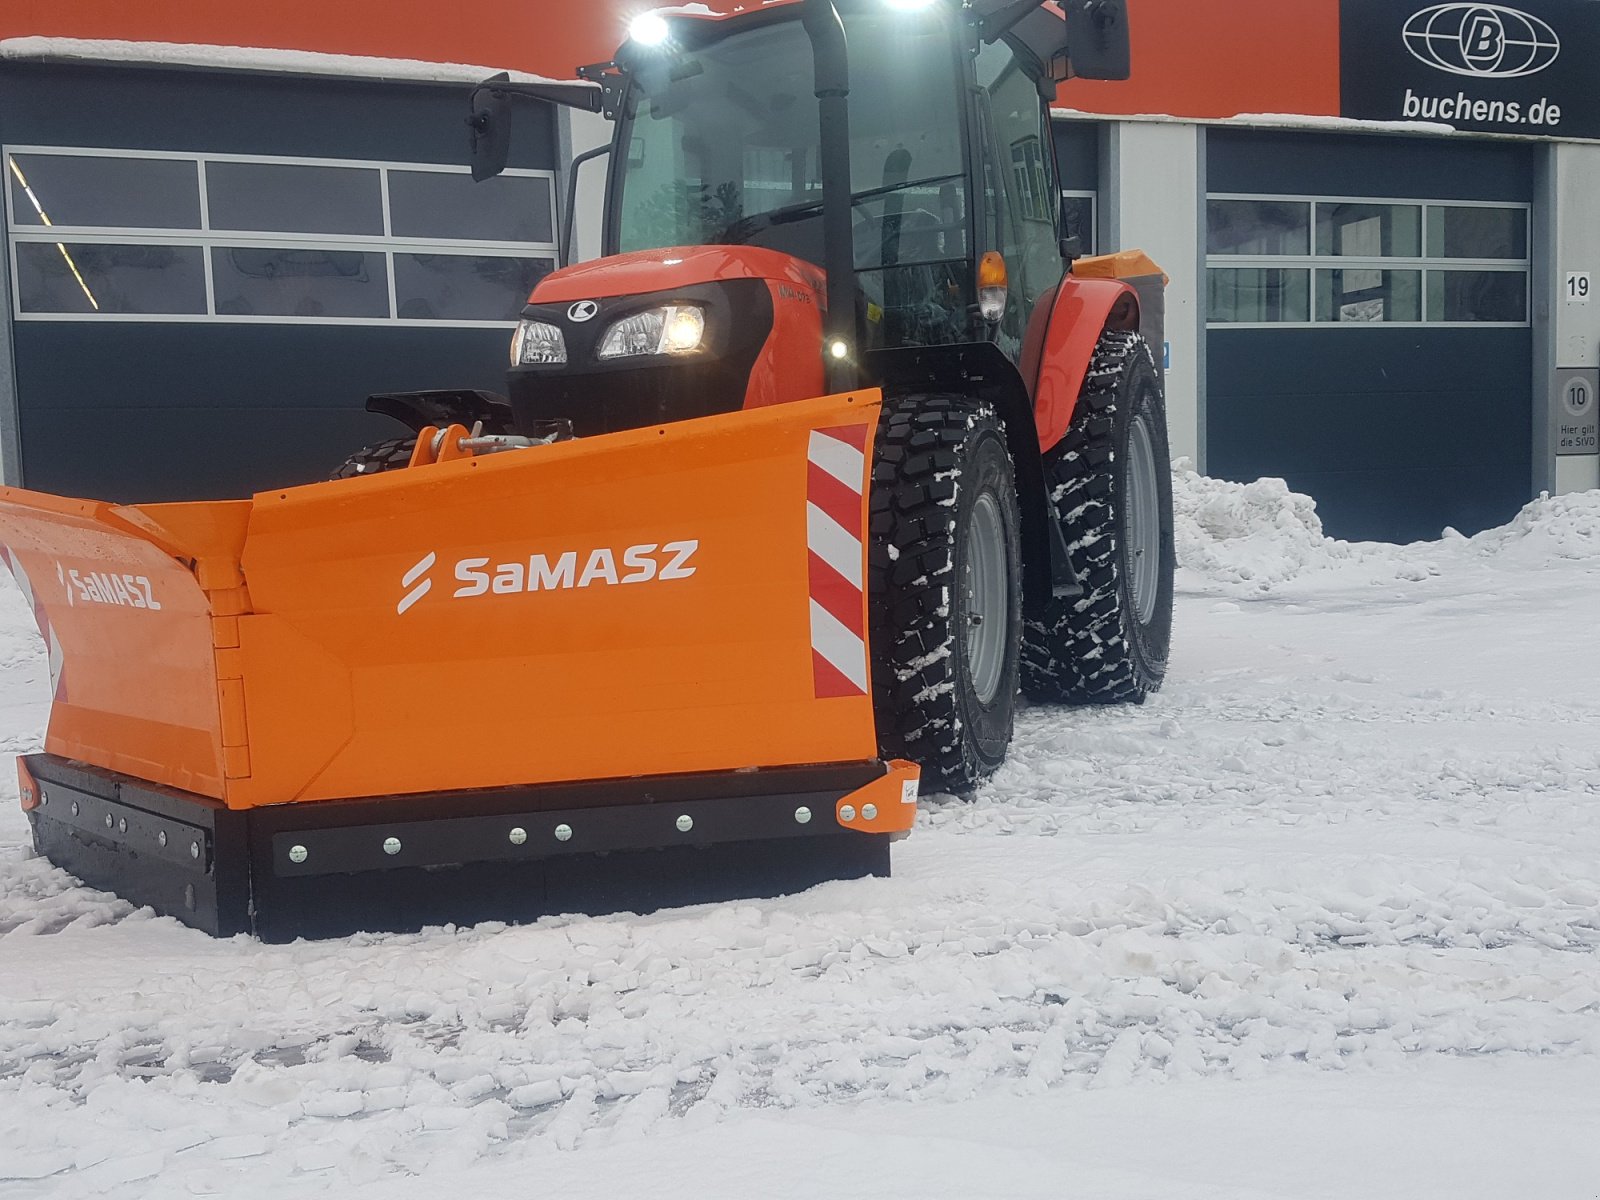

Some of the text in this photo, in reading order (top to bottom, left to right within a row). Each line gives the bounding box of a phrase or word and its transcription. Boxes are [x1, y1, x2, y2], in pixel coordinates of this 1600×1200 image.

[1402, 89, 1561, 125] buchens.de
[1567, 276, 1589, 297] 19
[1570, 387, 1586, 406] 10
[1560, 424, 1578, 434] Hier
[1560, 437, 1573, 447] die
[453, 539, 699, 598] SaMASZ
[68, 569, 161, 610] SaMASZ
